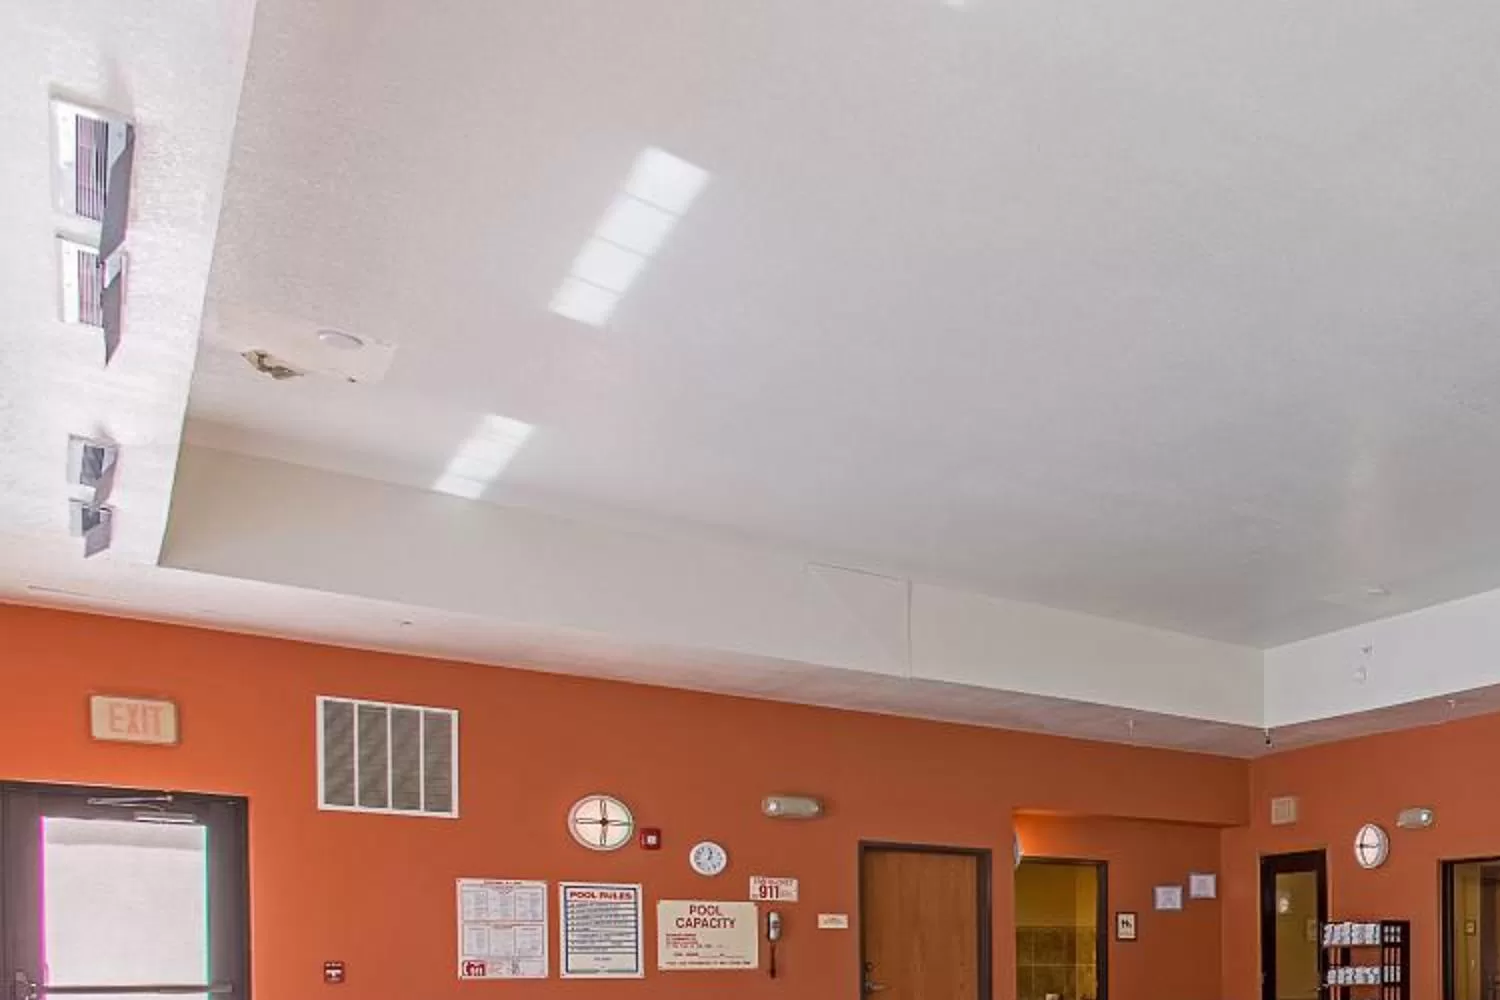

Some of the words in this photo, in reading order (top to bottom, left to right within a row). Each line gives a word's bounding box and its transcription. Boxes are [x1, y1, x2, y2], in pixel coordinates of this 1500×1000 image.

[109, 703, 164, 736] EXIT
[570, 891, 597, 899] POOL
[600, 892, 632, 900] RULES
[759, 885, 779, 899] 911
[689, 905, 722, 917] POOL
[675, 917, 736, 929] CAPACITY
